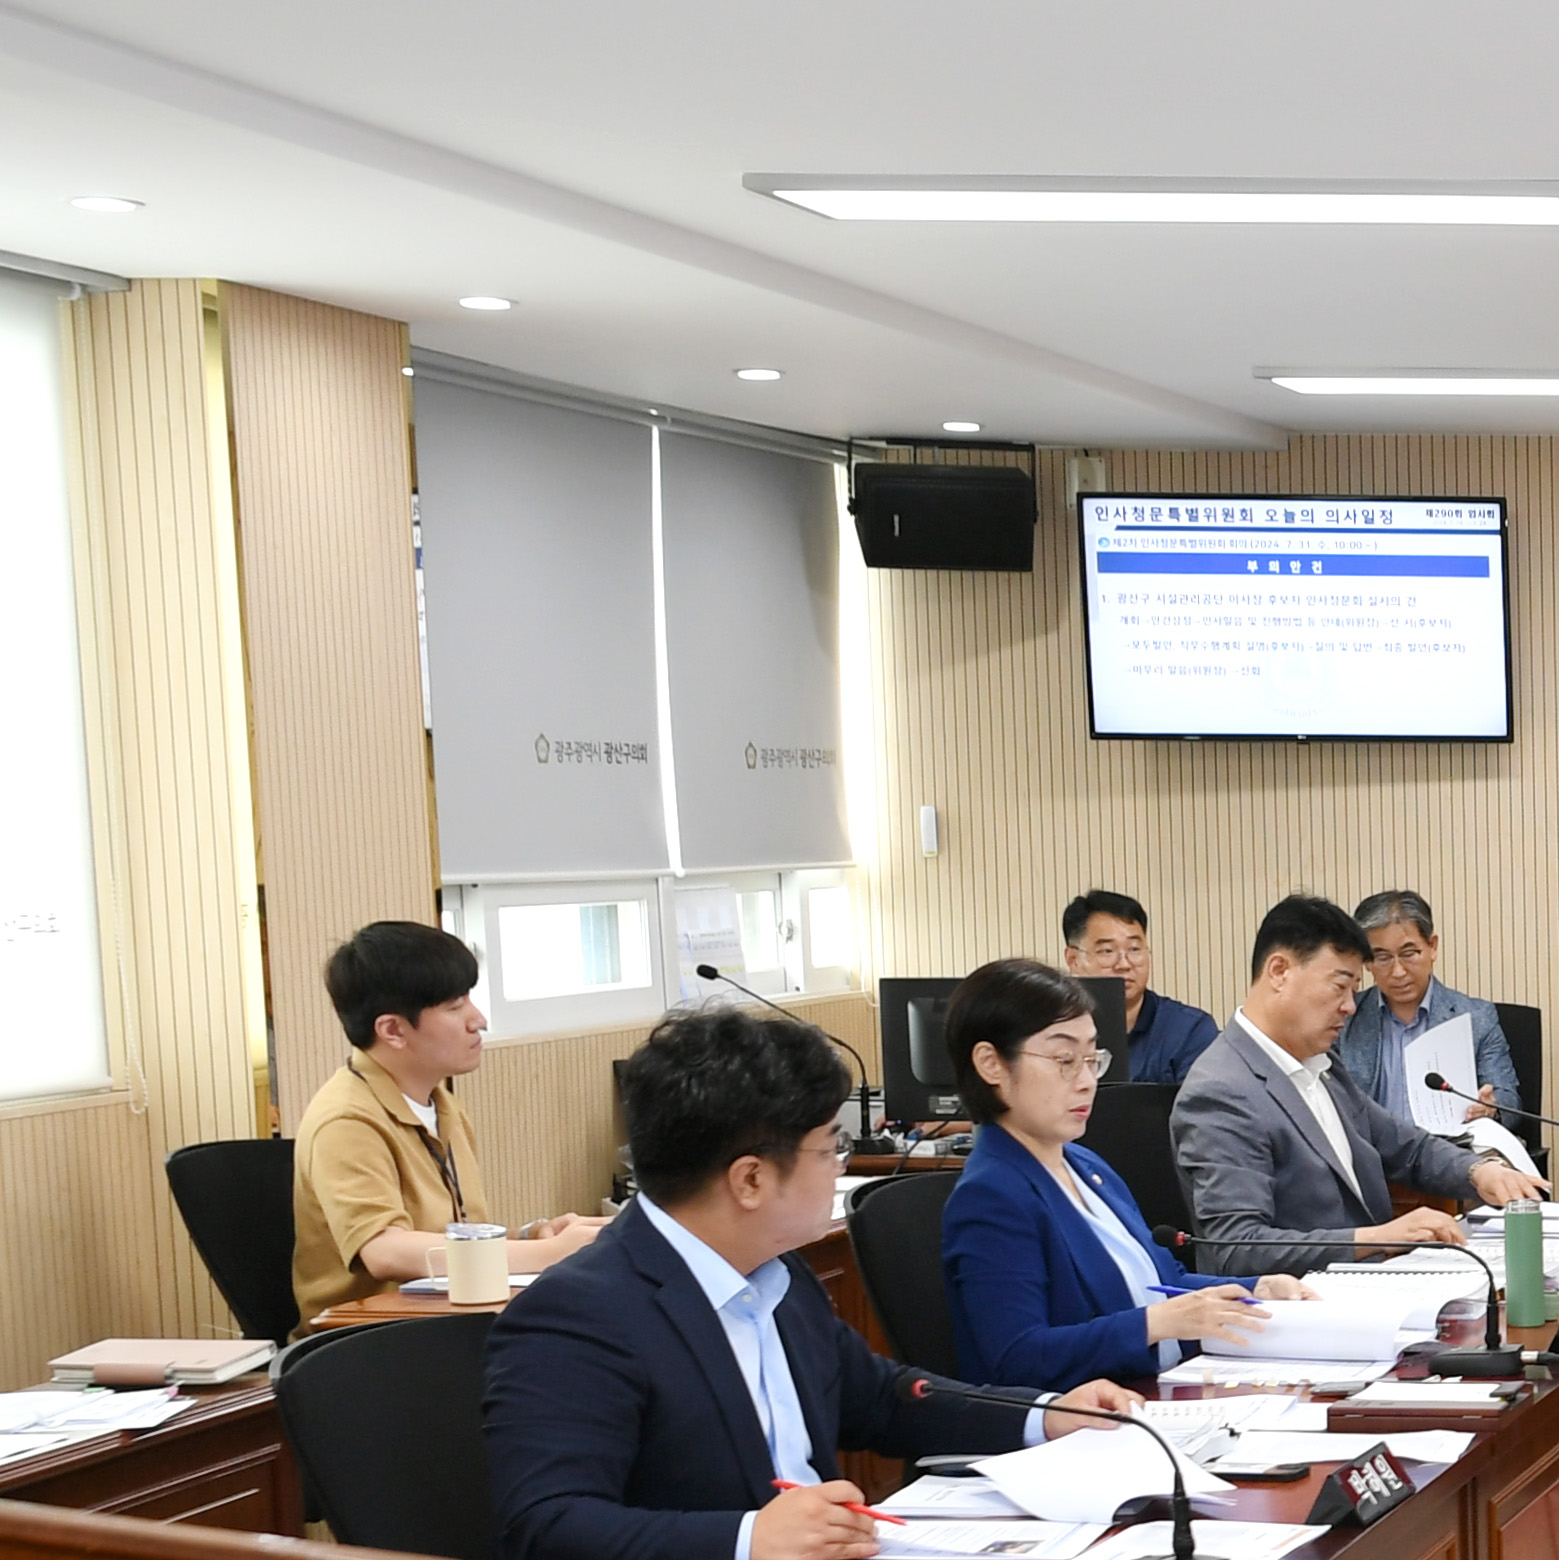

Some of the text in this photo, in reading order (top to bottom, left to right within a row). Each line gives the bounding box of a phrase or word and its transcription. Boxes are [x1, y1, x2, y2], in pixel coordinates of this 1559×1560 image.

[1095, 505, 1393, 525] 인사청문특별위원회 오늘의 의사일정
[554, 740, 648, 765] 광주광역시 광산구의회
